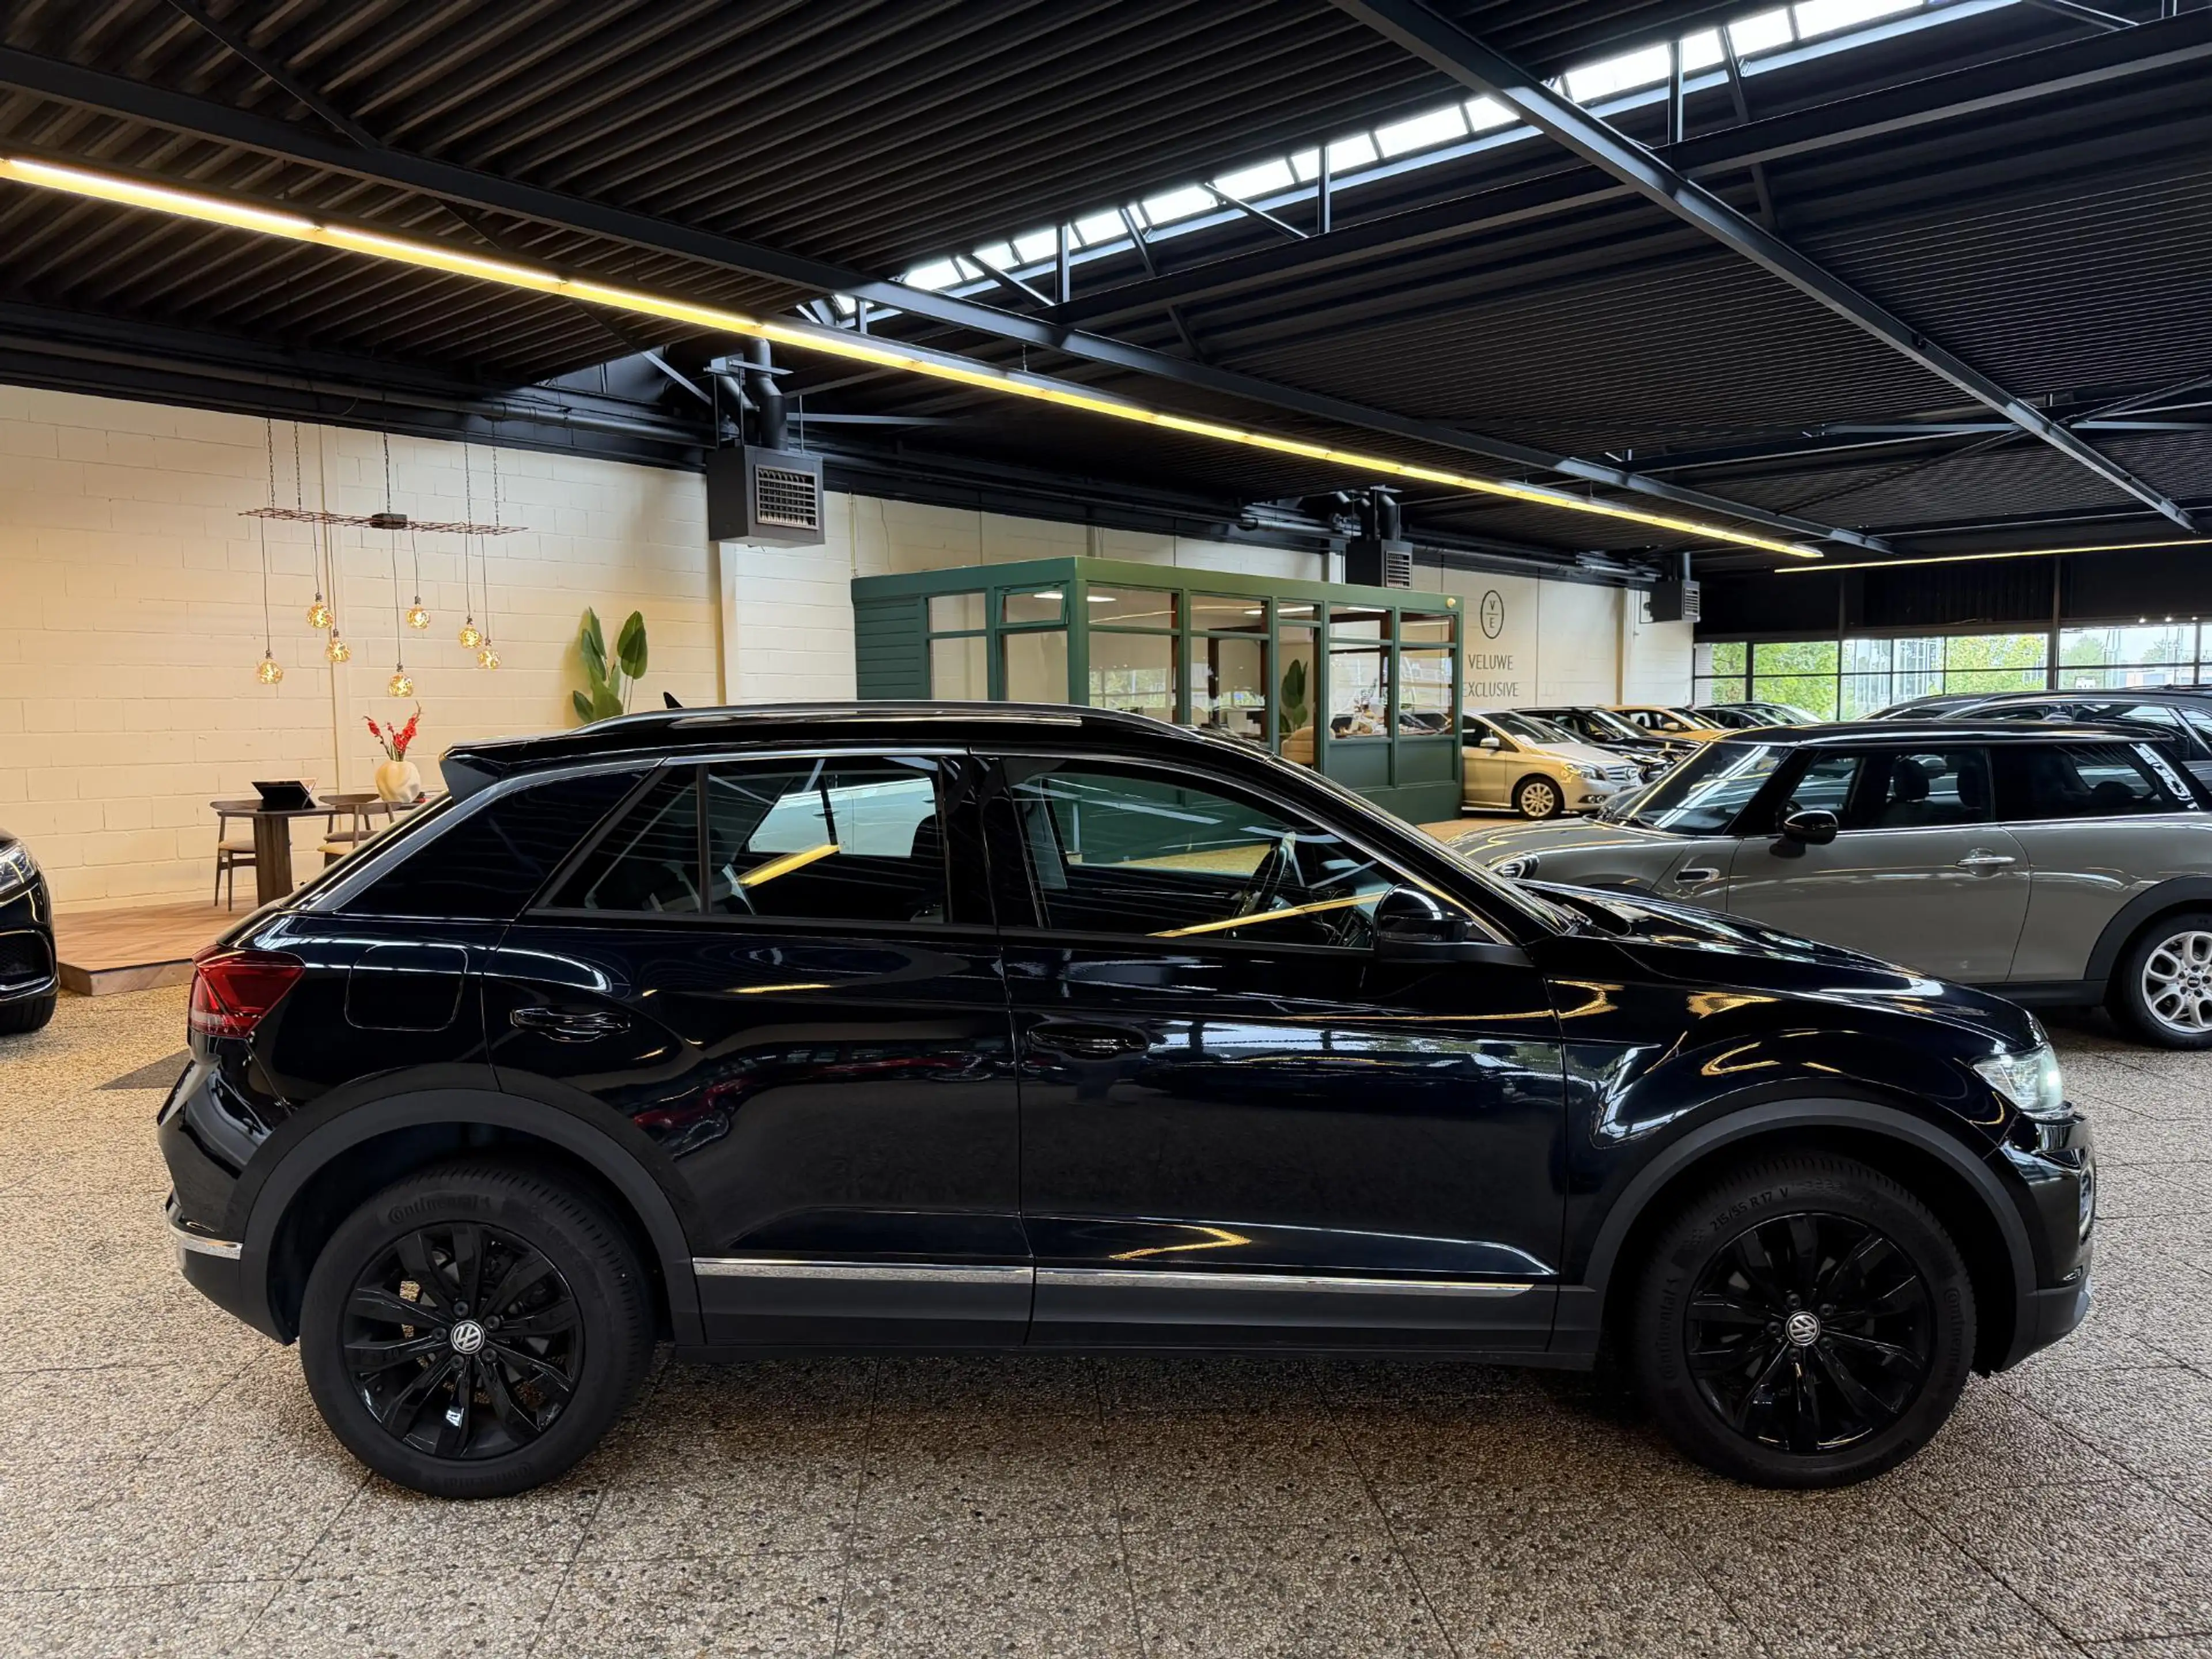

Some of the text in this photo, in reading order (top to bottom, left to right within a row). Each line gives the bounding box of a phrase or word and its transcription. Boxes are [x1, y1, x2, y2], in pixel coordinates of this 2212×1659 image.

[1489, 600, 1495, 610] V
[1489, 618, 1495, 628] E
[1468, 654, 1513, 671] VELUWE
[388, 1195, 479, 1225] Continental
